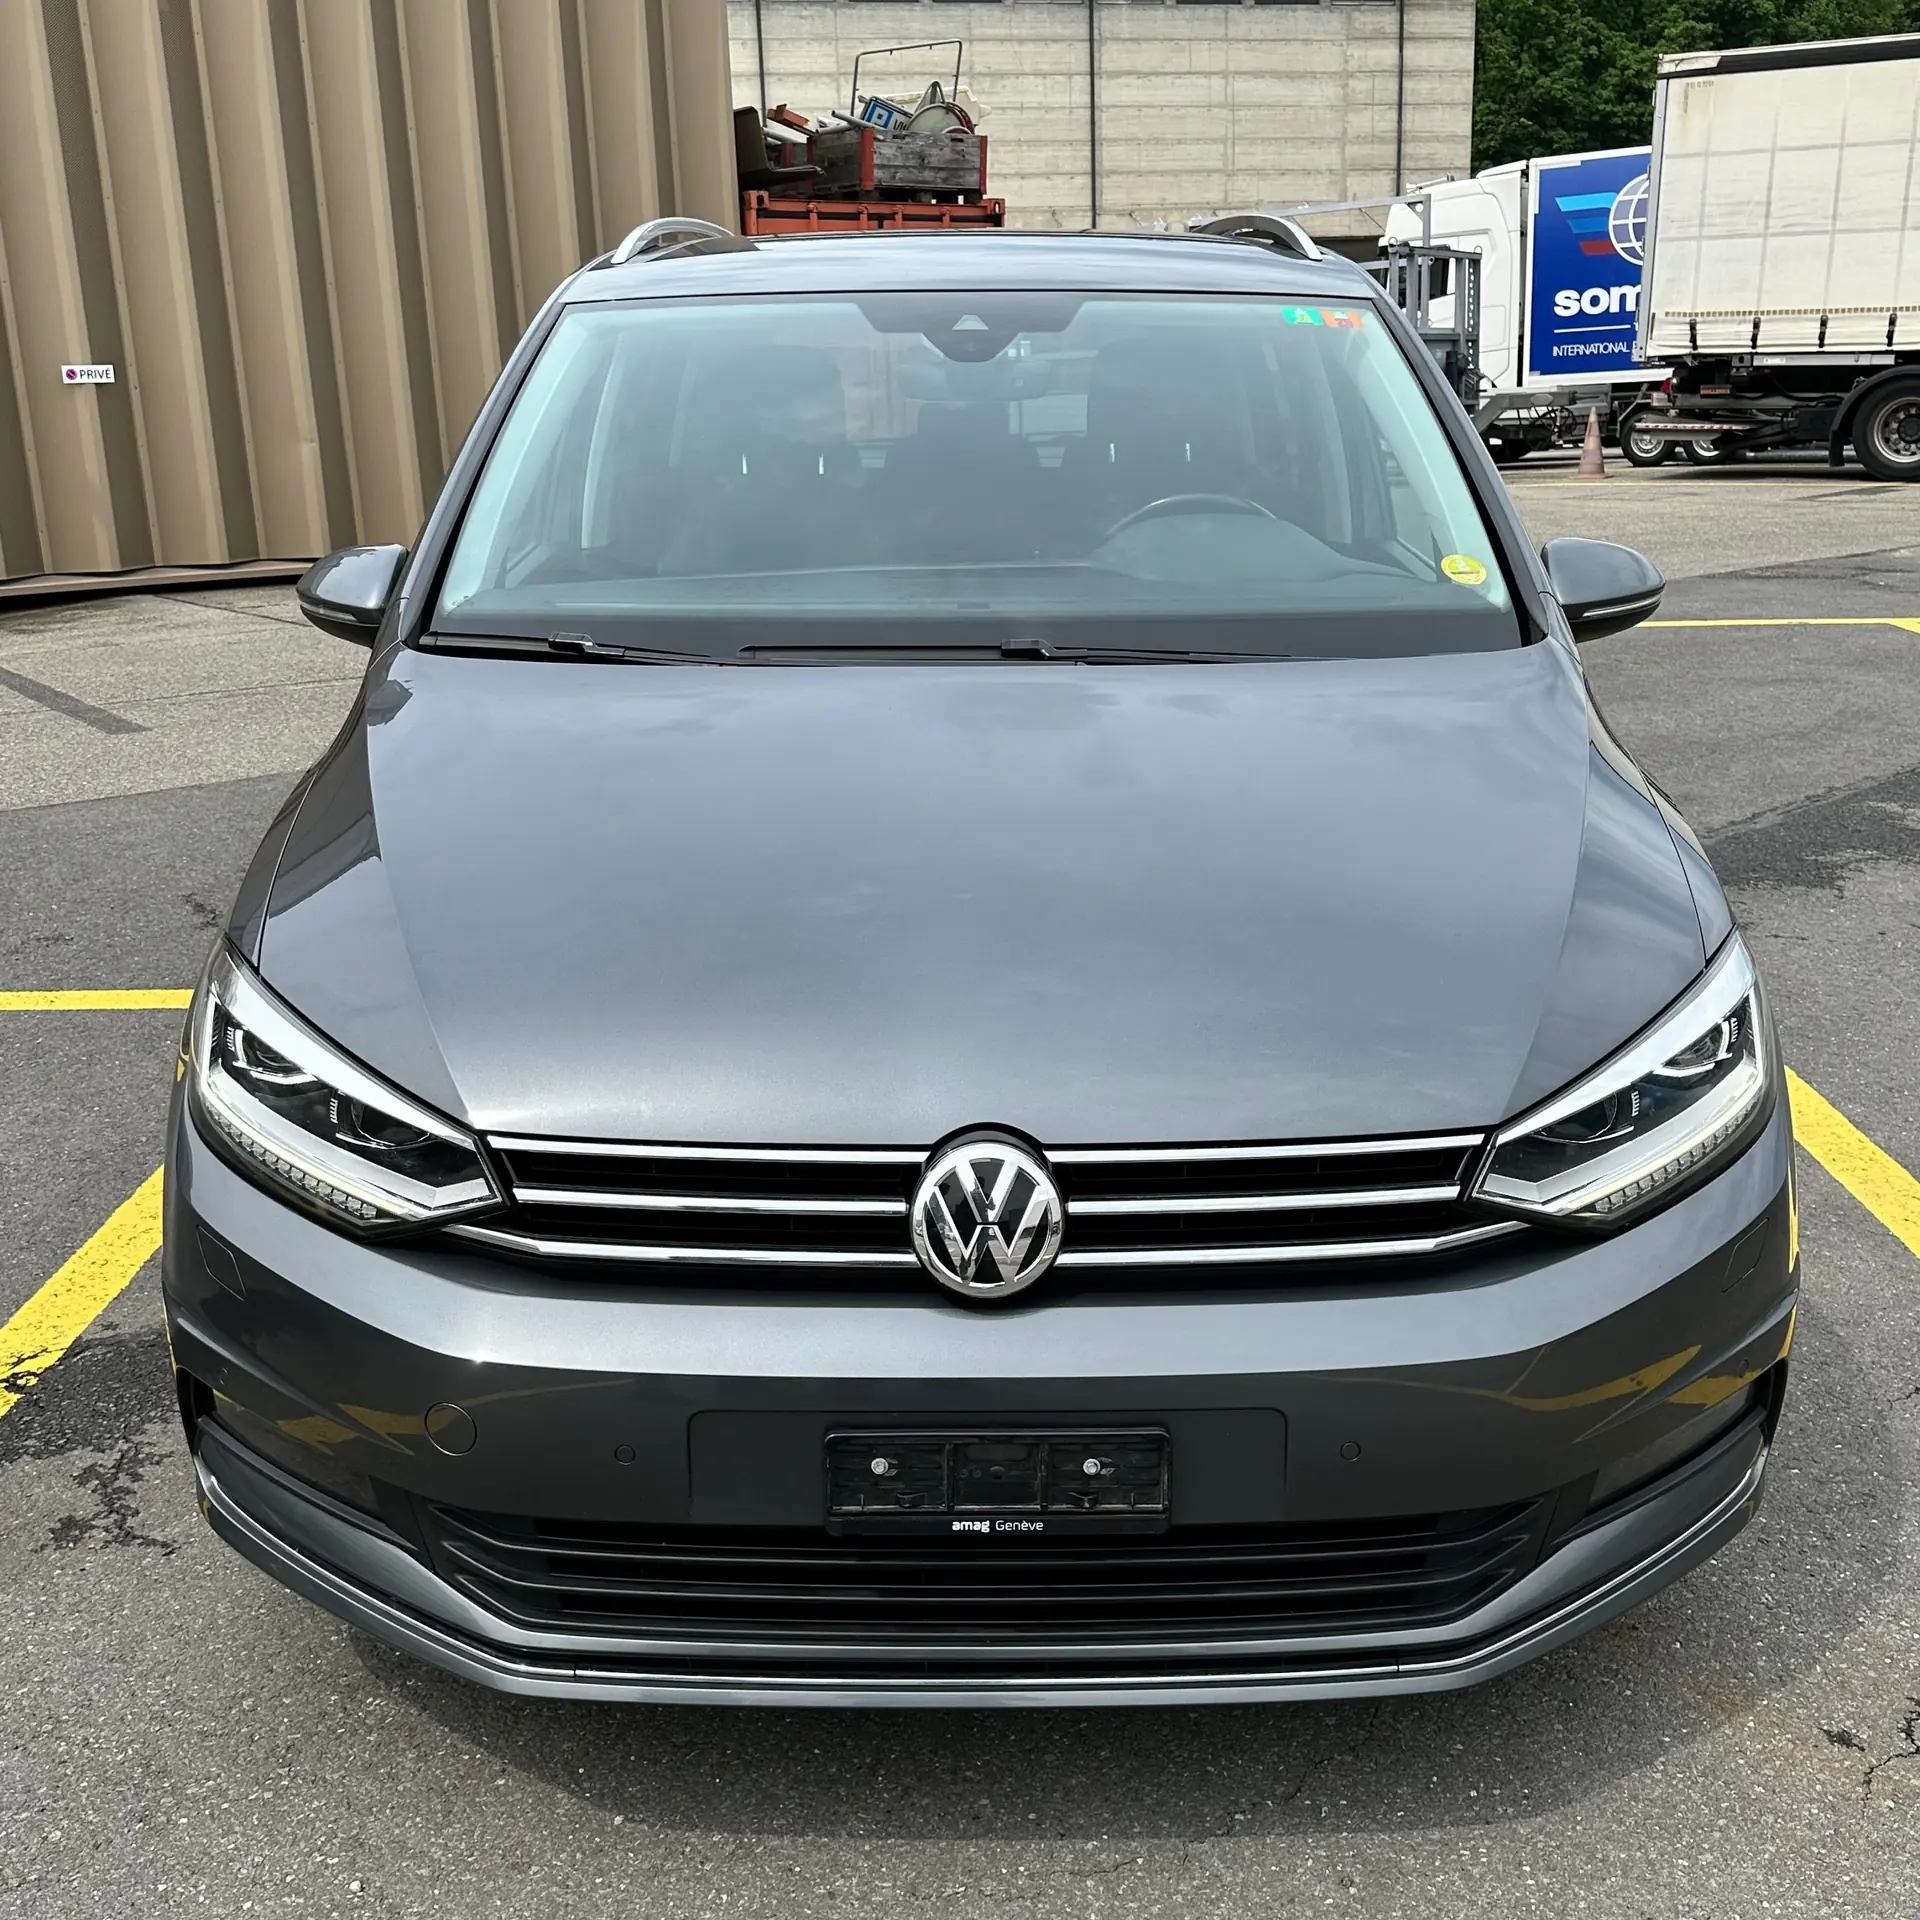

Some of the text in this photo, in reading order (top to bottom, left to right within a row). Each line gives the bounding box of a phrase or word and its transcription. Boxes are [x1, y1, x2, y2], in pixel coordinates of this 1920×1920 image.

[1553, 284, 1642, 317] som
[1552, 341, 1630, 357] INTERNATIONAL
[79, 368, 112, 380] PRIVÉ
[917, 1147, 1059, 1293] VW
[952, 1520, 1044, 1533] amag Genève
